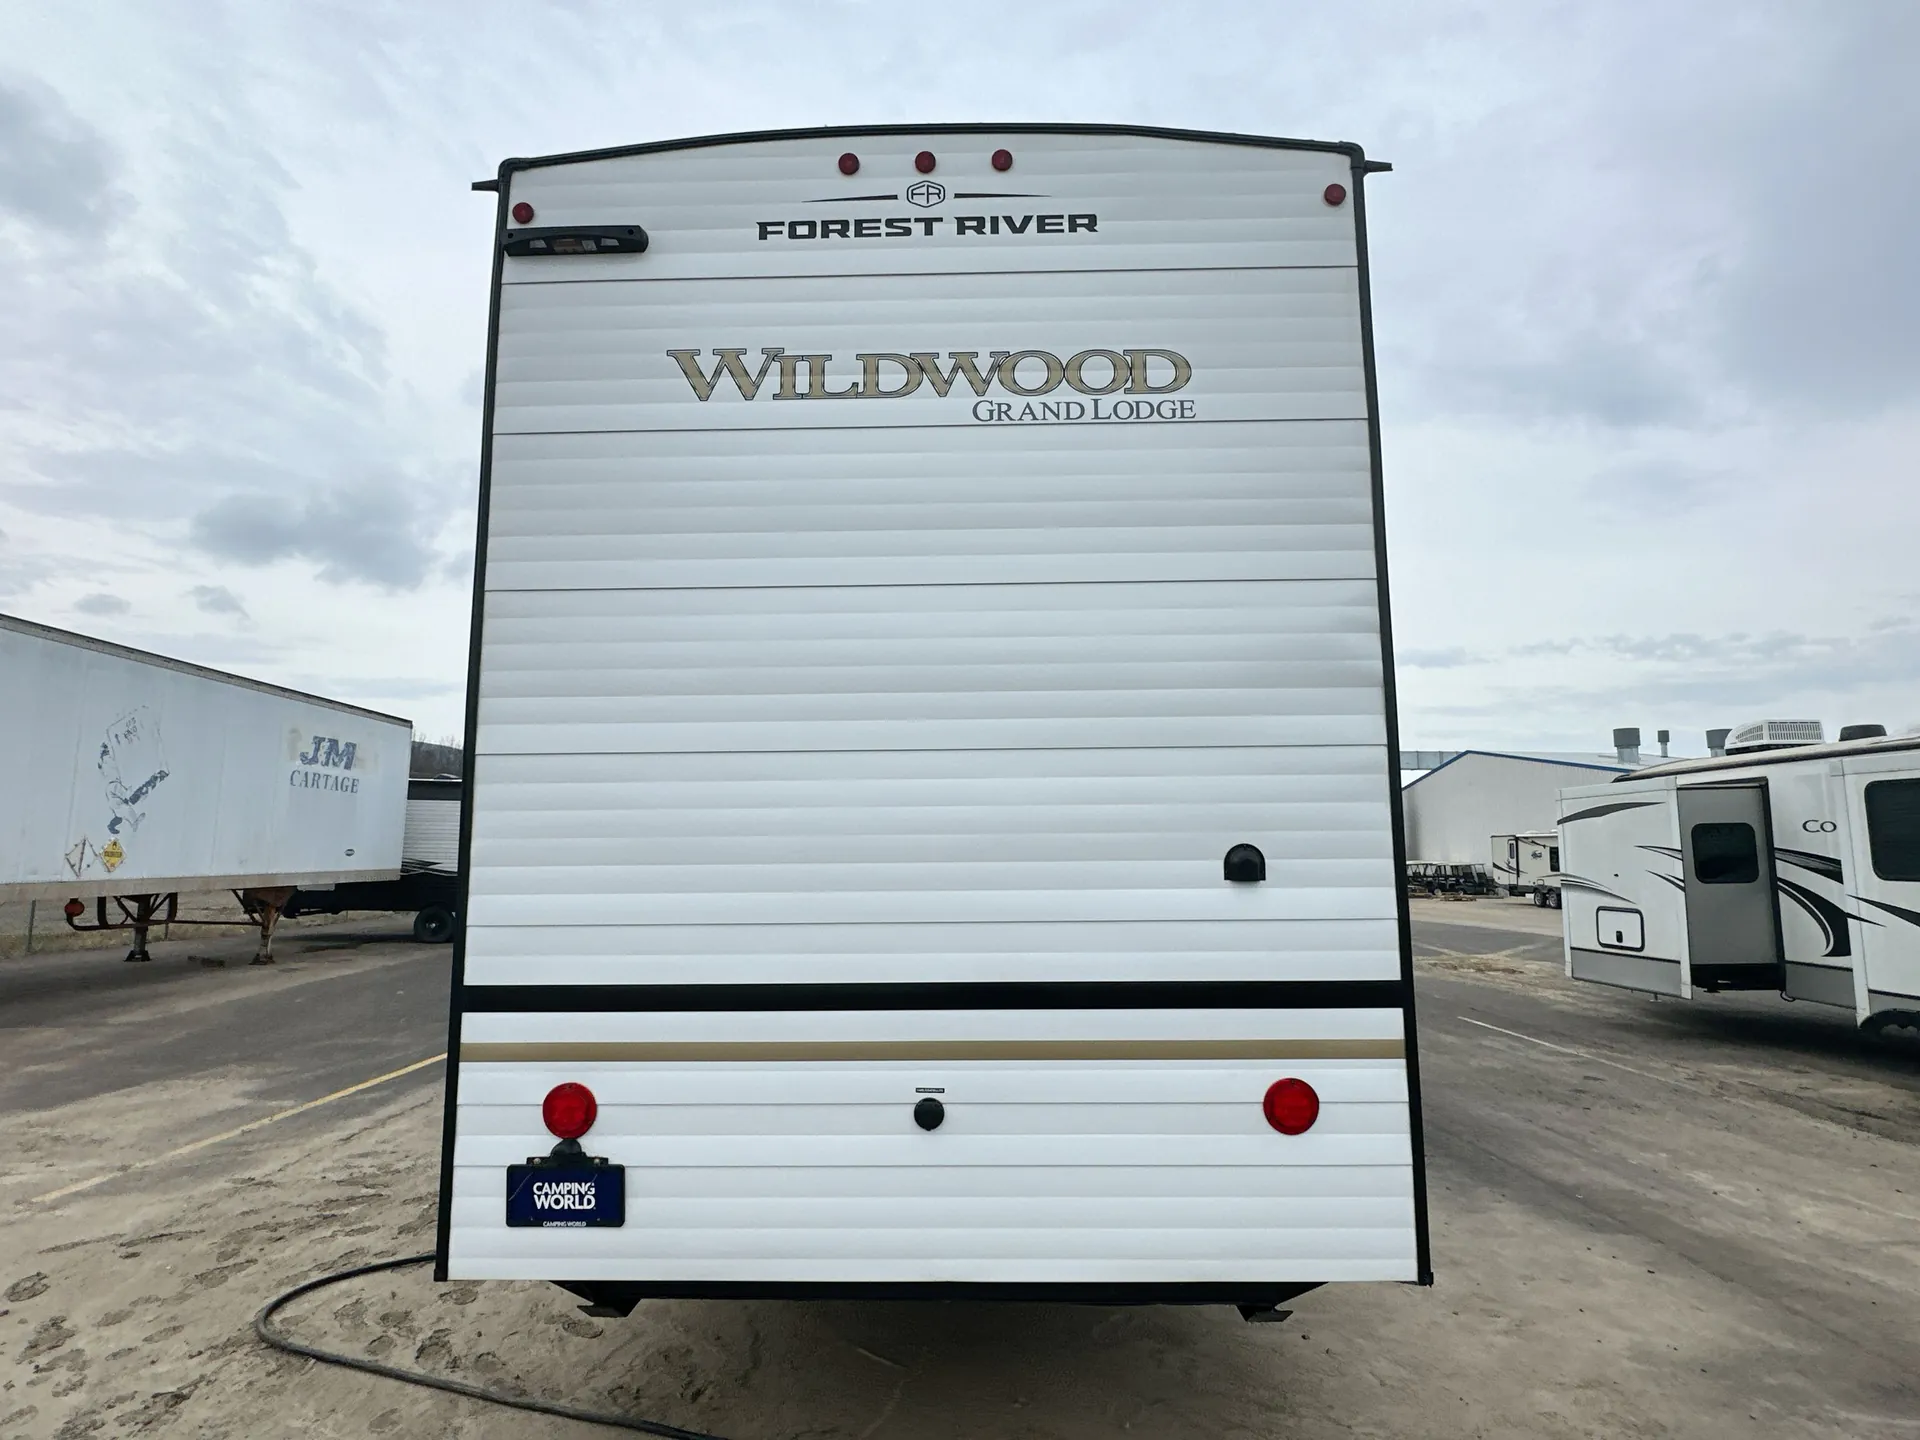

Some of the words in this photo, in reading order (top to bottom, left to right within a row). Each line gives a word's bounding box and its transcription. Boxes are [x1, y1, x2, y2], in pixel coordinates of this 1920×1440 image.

[756, 217, 943, 240] FOREST
[954, 213, 1099, 236] RIVER
[667, 348, 1192, 401] WILDWOOD
[972, 399, 1085, 422] GRAND
[1090, 398, 1197, 420] LODGE
[299, 735, 358, 771] JM
[290, 769, 360, 794] CARTAGE
[533, 1182, 595, 1195] CAMPING
[533, 1195, 596, 1209] WORLD
